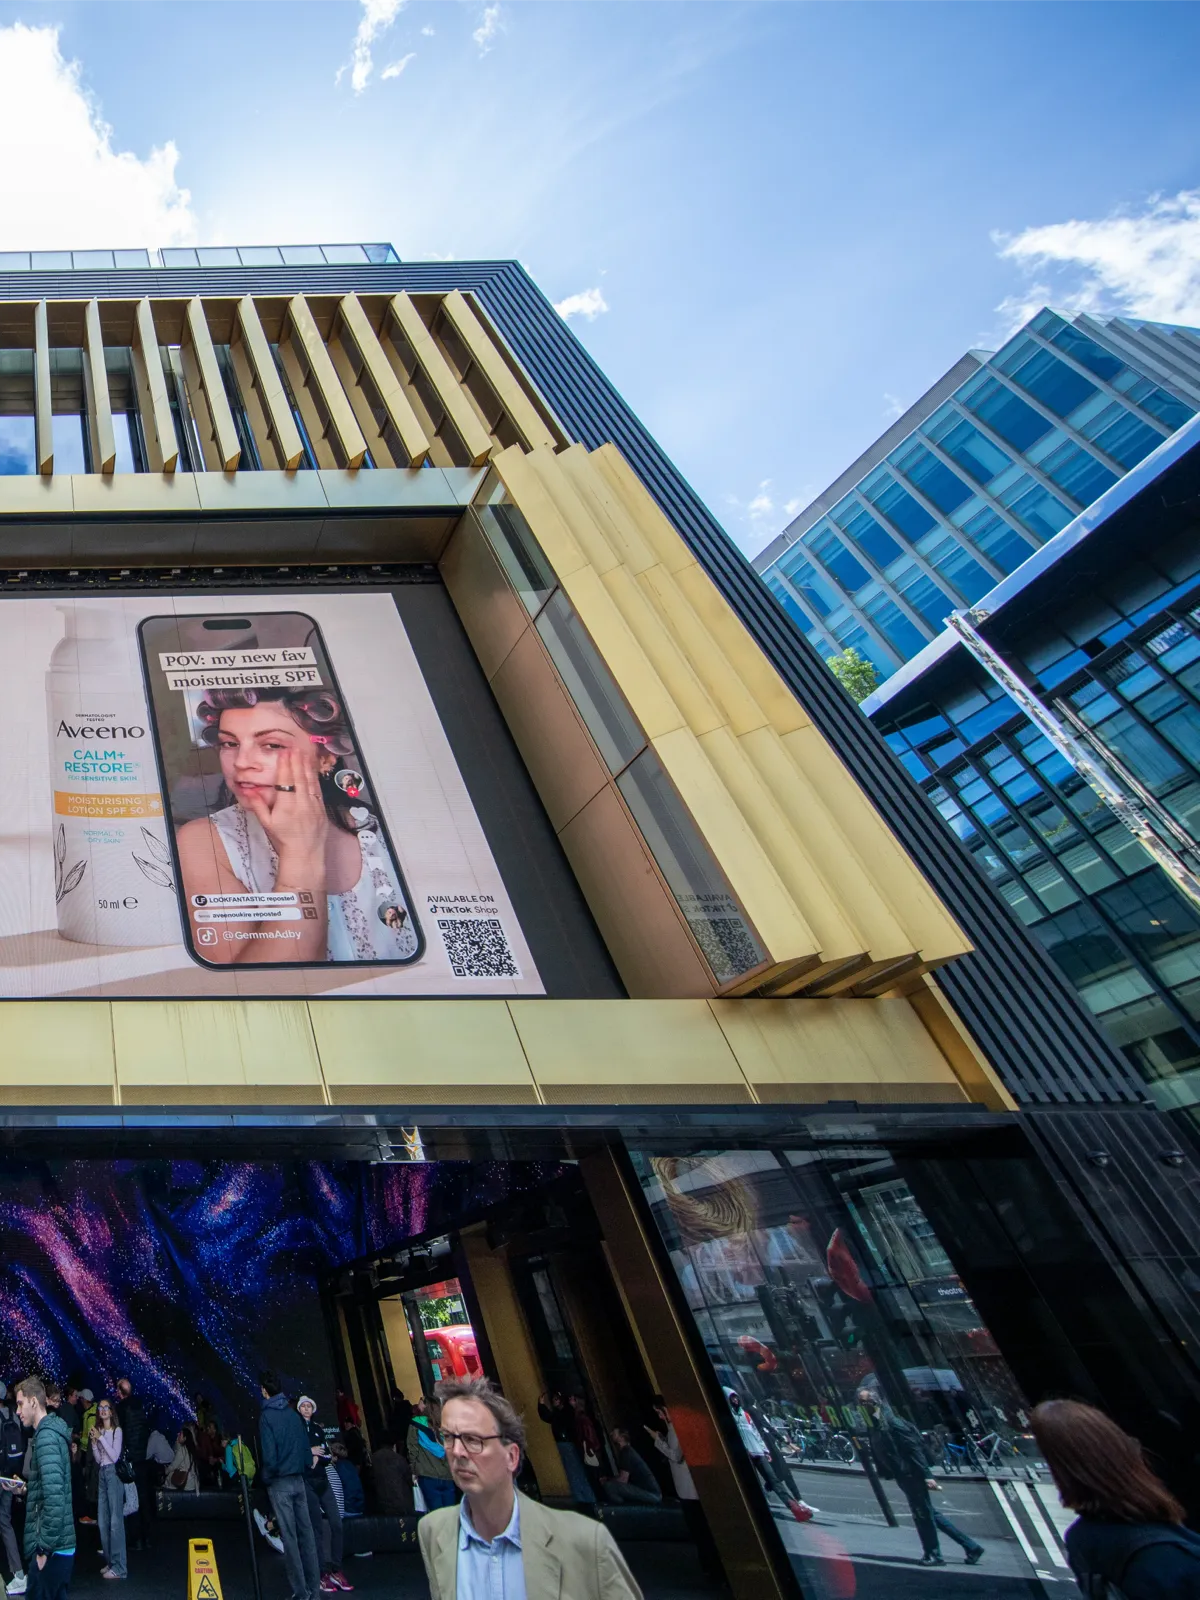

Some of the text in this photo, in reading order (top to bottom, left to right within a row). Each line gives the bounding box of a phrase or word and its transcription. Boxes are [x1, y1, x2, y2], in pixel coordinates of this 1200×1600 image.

[165, 650, 307, 667] POV: my new fav
[173, 670, 316, 687] moisturising SPF
[56, 719, 145, 739] Aveeno
[73, 749, 126, 761] CALM+
[68, 796, 142, 805] MOISTURISING
[67, 806, 145, 815] LOTION SPF 50
[98, 899, 108, 909] 50
[110, 899, 120, 909] ml
[209, 895, 295, 904] LOOKFANTASTIC reposted
[427, 895, 495, 903] AVAILABLE ON
[253, 911, 282, 919] reposted
[440, 905, 499, 915] TikTok Shop
